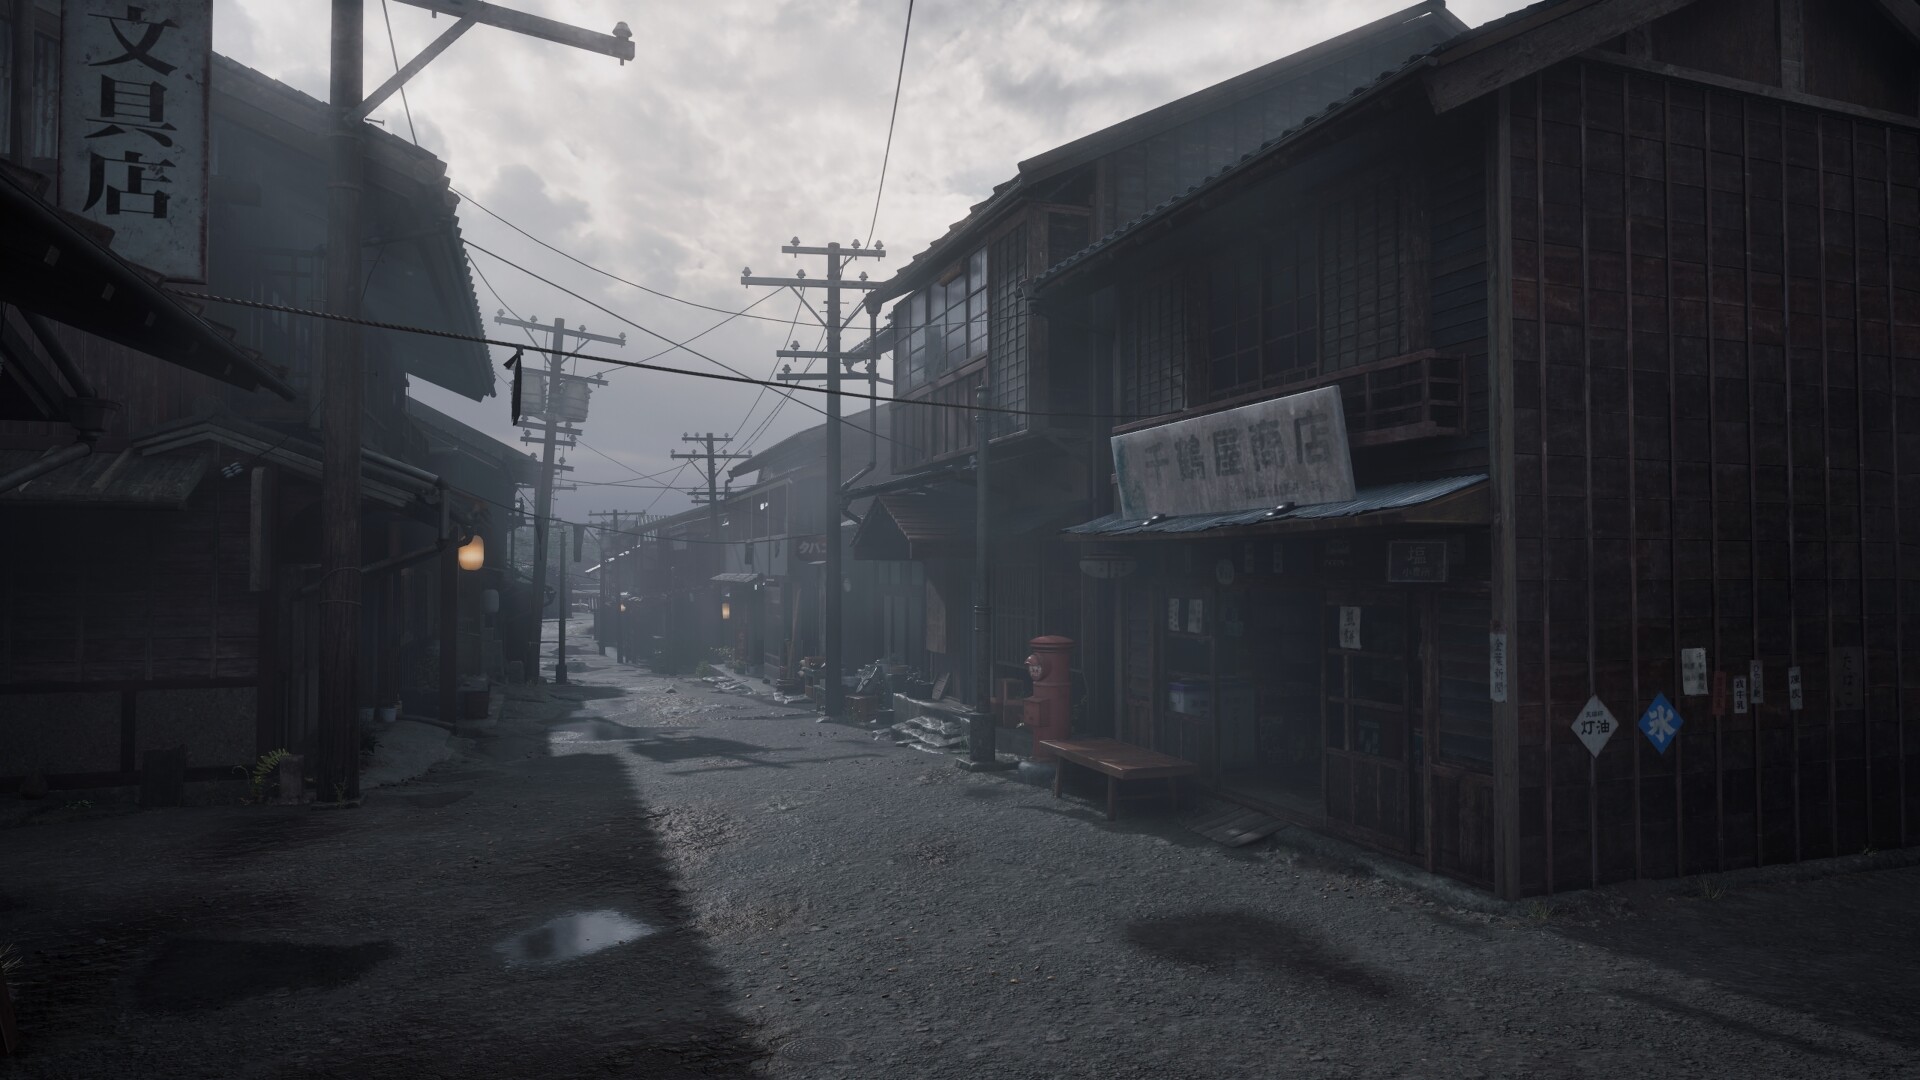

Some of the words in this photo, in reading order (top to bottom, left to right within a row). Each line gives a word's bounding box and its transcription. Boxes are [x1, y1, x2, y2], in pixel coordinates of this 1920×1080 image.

[83, 6, 179, 219] 文具店
[1144, 410, 1331, 484] 千鶴屋商店
[1408, 546, 1427, 565] 塩
[1843, 652, 1857, 706] たばこ
[1581, 720, 1610, 735] 灯油
[1648, 704, 1676, 743] 氷
